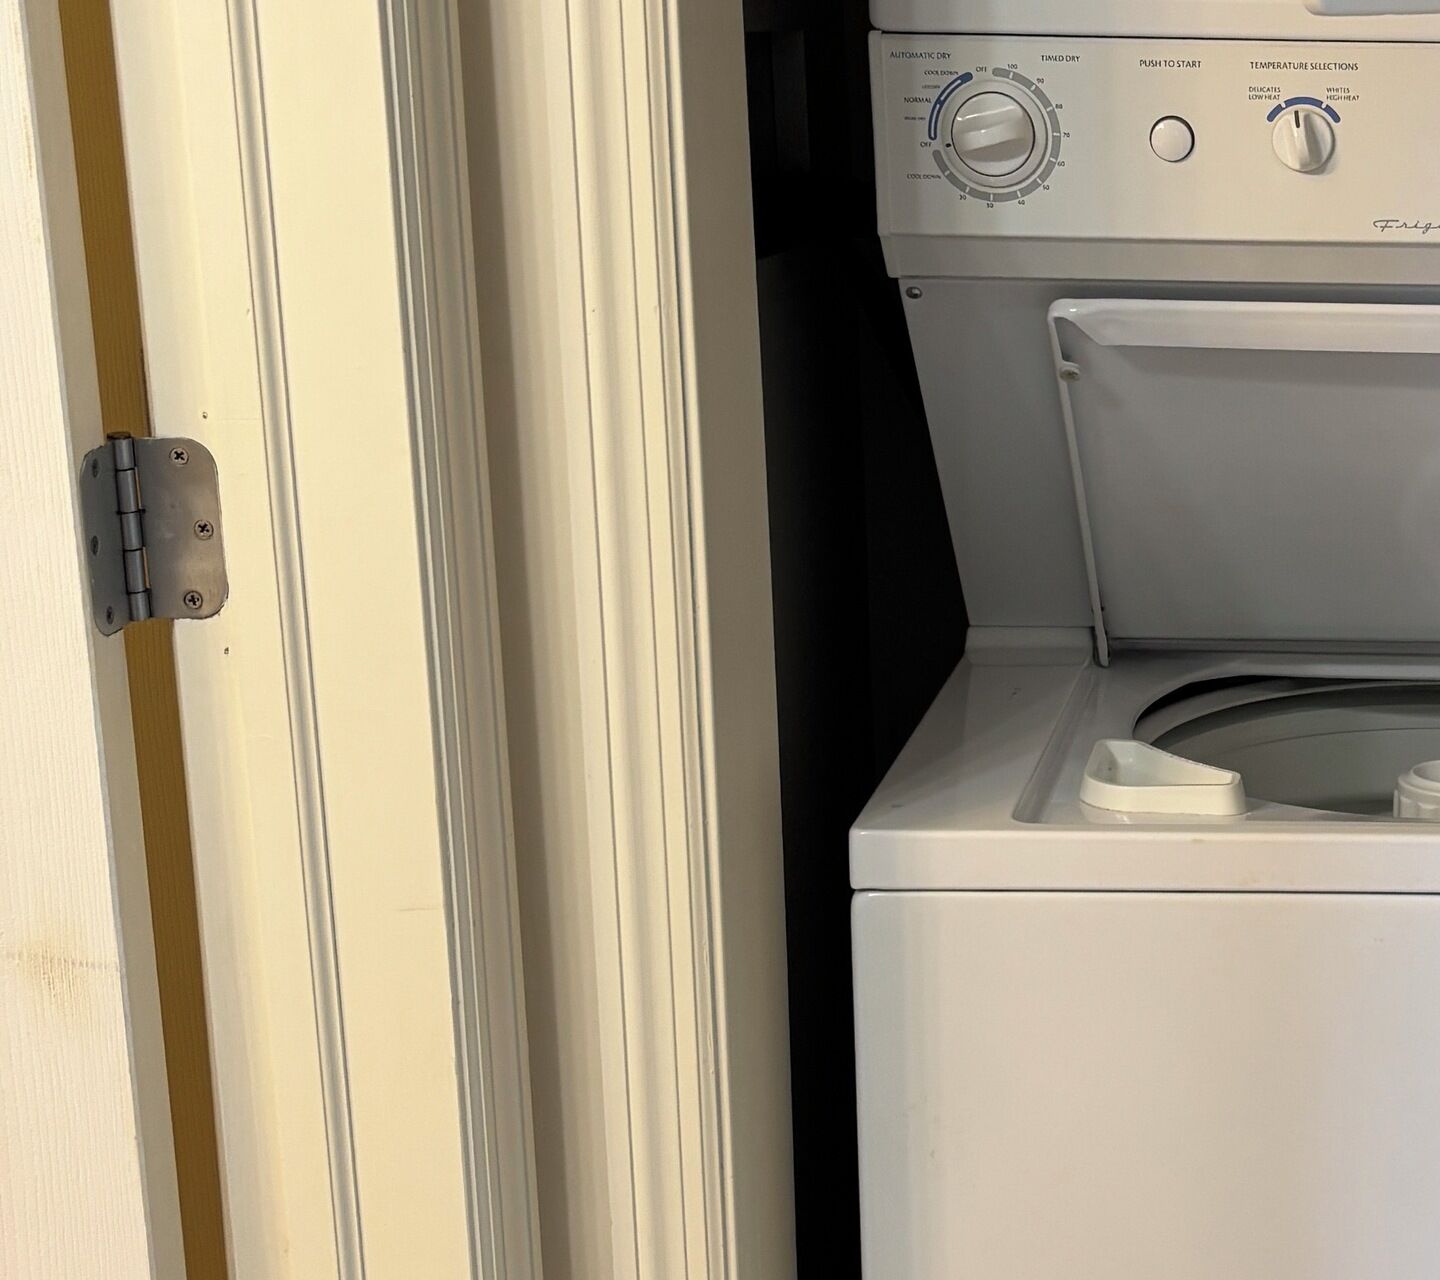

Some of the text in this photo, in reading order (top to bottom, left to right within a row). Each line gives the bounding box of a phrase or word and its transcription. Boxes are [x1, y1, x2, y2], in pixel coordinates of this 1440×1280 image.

[1140, 60, 1161, 68] PUSH
[1162, 60, 1175, 68] TO
[1250, 62, 1359, 71] TEMPERATURE SELECTIONS
